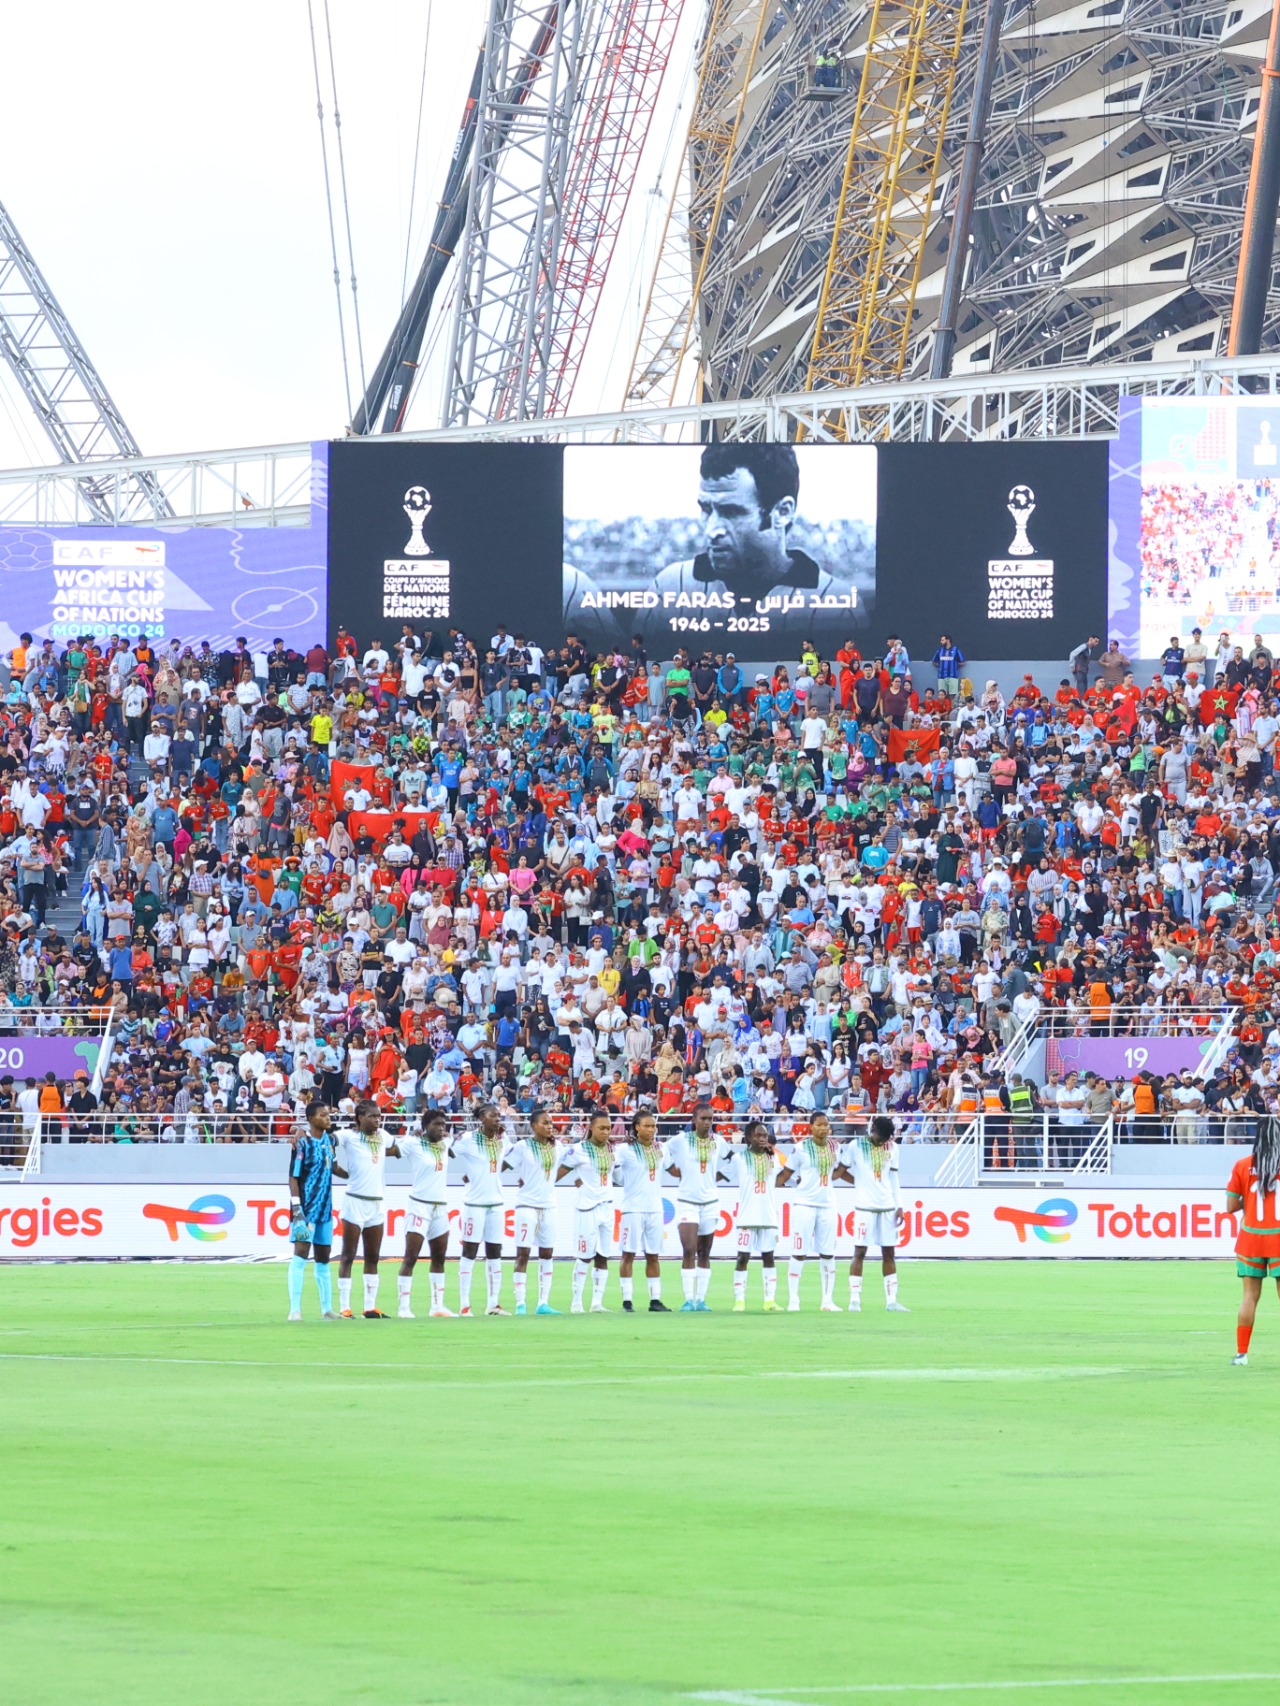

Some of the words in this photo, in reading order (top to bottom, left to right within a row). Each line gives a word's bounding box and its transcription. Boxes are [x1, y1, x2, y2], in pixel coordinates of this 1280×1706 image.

[58, 546, 113, 559] CAF
[387, 563, 419, 572] CAF
[991, 564, 1023, 572] CAF
[53, 568, 165, 589] WOMEN'S
[384, 576, 409, 584] COUPE
[988, 576, 1053, 589] WOMEN'S
[384, 584, 403, 593] DES
[403, 584, 450, 593] NATIONS
[988, 589, 1030, 600] AFRICA
[1030, 589, 1053, 600] CUP
[53, 589, 123, 605] AFRICA
[126, 589, 165, 605] CUP
[383, 592, 450, 607] FÉMININE
[580, 591, 659, 609] AHMED
[663, 591, 736, 609] FARAS
[755, 590, 805, 614] فرس
[809, 587, 858, 609] أحمد
[988, 600, 1004, 610] OF
[1005, 600, 1053, 610] NATIONS
[53, 606, 79, 622] OF
[82, 606, 165, 622] NATIONS
[383, 607, 431, 618] MAROC
[433, 607, 449, 618] 24
[987, 610, 1040, 619] MOROCCO
[1040, 610, 1053, 619] 24
[52, 623, 140, 637] MOROCCO
[144, 623, 165, 637] 24
[669, 617, 710, 632] 1946
[727, 617, 770, 632] 2025
[0, 1047, 24, 1069] 20
[1124, 1047, 1148, 1068] 19
[754, 1181, 766, 1194] 20
[464, 1221, 474, 1237] 13
[520, 1228, 528, 1242] 7
[578, 1240, 587, 1253] 18
[737, 1232, 749, 1247] 20
